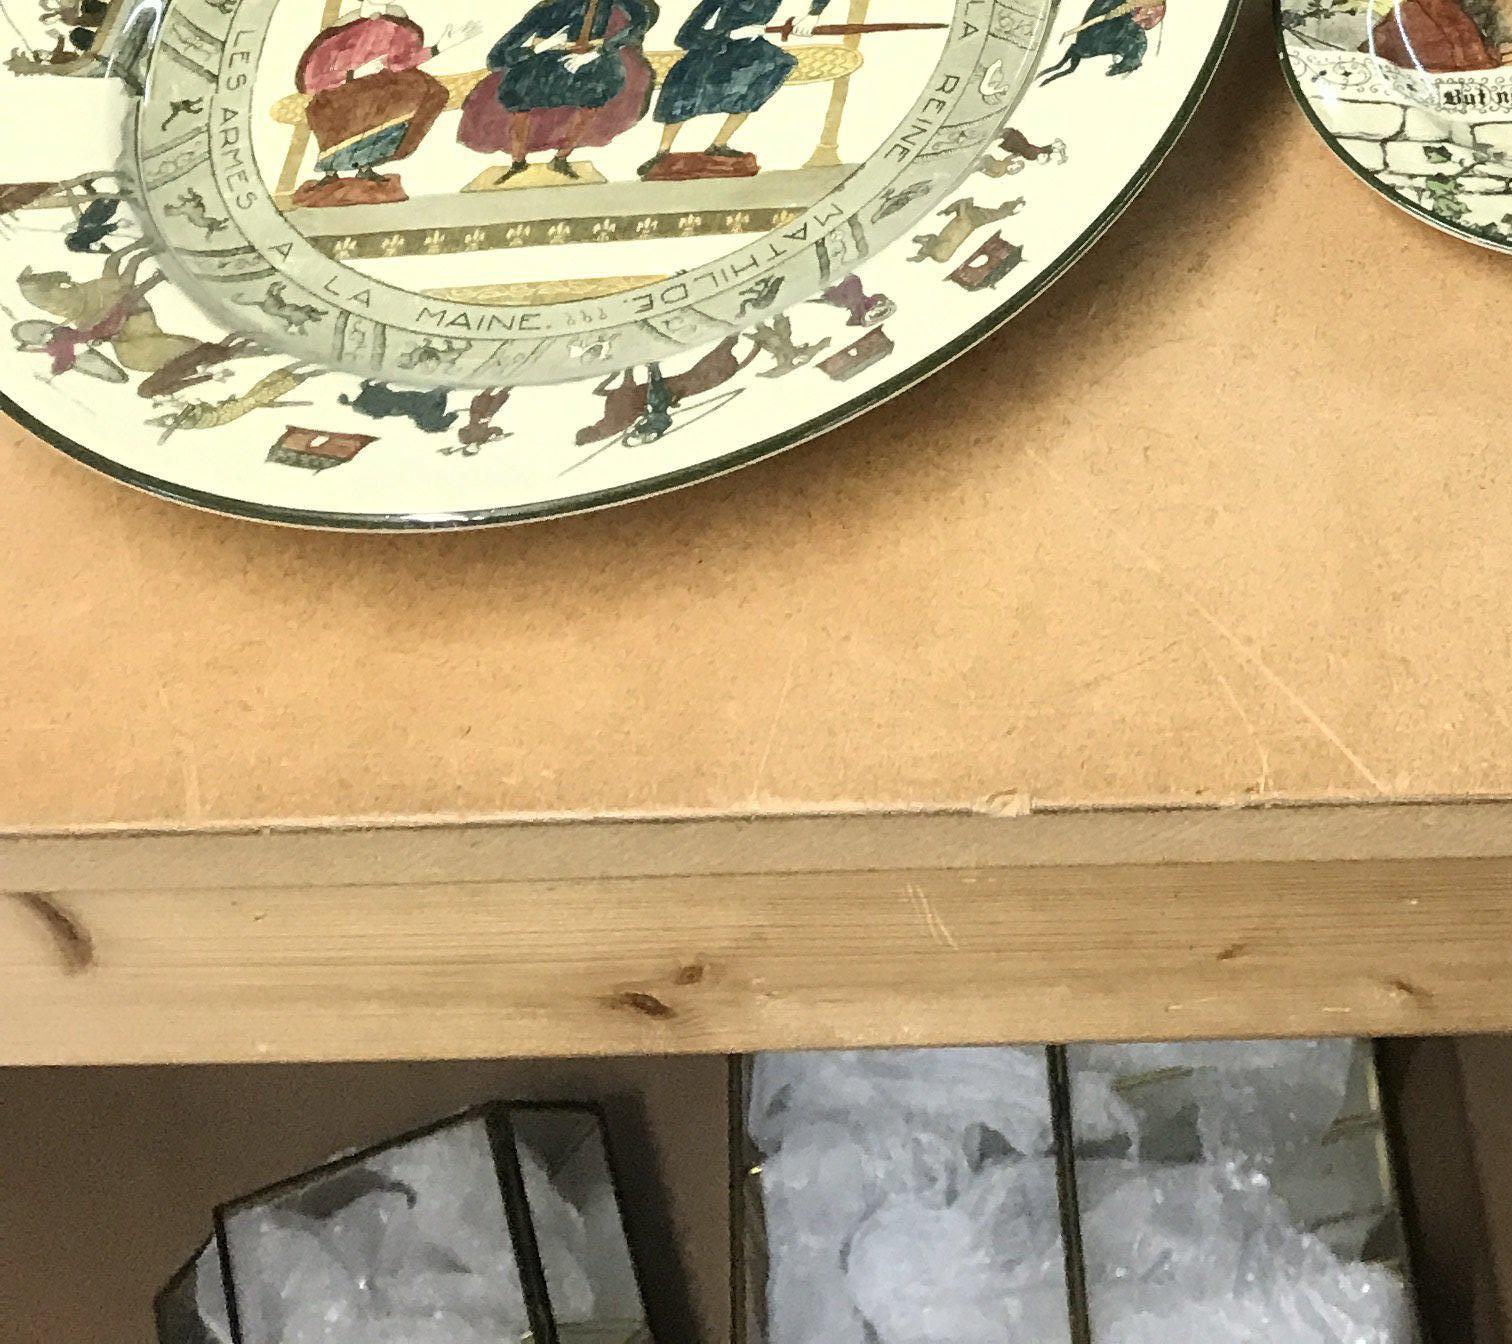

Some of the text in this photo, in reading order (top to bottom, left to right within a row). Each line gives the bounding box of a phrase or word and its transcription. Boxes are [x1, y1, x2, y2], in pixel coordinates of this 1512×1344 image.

[226, 28, 257, 92] LES
[883, 73, 960, 162] REINE
[1443, 86, 1486, 106] But
[219, 107, 258, 210] ARMES
[268, 241, 294, 263] A
[323, 275, 371, 308] LA
